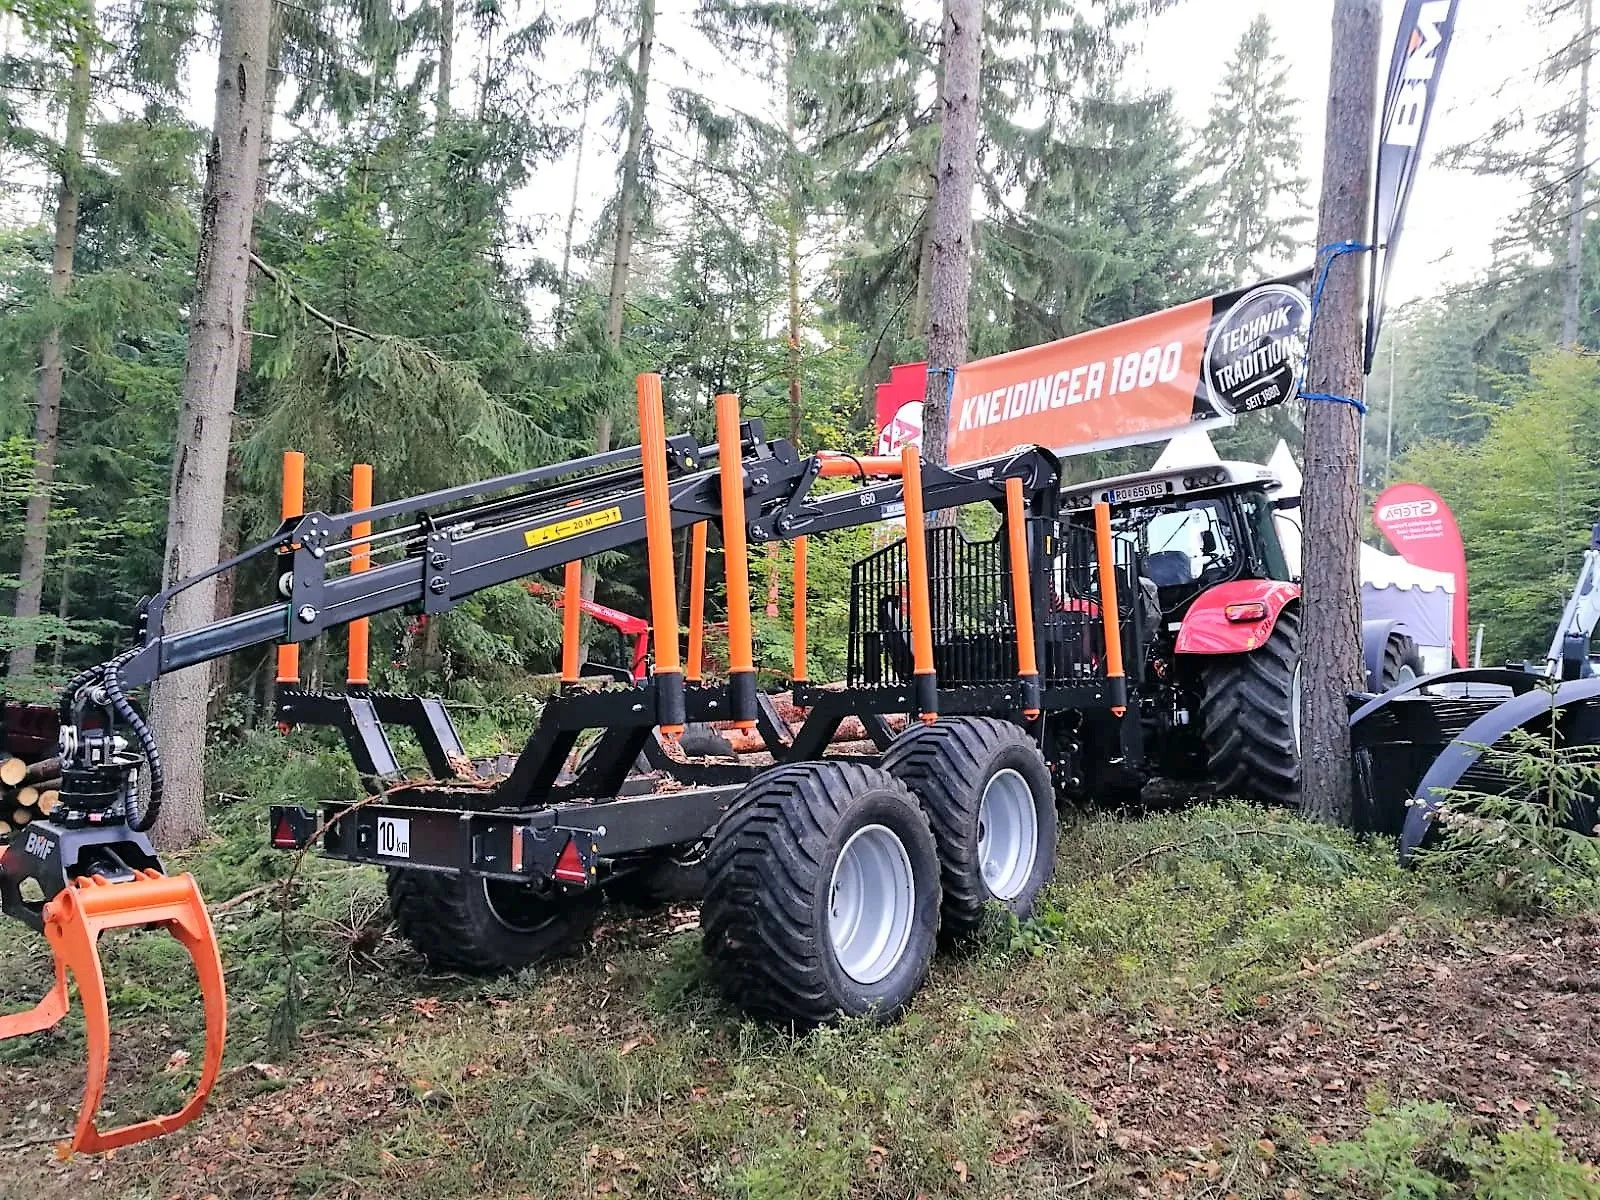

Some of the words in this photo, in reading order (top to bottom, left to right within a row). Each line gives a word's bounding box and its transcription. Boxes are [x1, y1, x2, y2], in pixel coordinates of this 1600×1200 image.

[1221, 306, 1292, 355] TECHNIK
[1216, 335, 1300, 392] TRADITION
[958, 361, 1106, 432] KNEIDINGER
[1109, 341, 1183, 396] 1880
[1245, 394, 1263, 411] SEIT
[1261, 384, 1281, 406] 1880
[860, 493, 876, 506] 850
[1116, 489, 1127, 500] RO
[1150, 483, 1163, 495] DS
[573, 520, 584, 531] 20
[585, 518, 593, 527] M
[25, 831, 56, 860] BMF
[380, 821, 394, 851] 10
[397, 836, 407, 853] km
